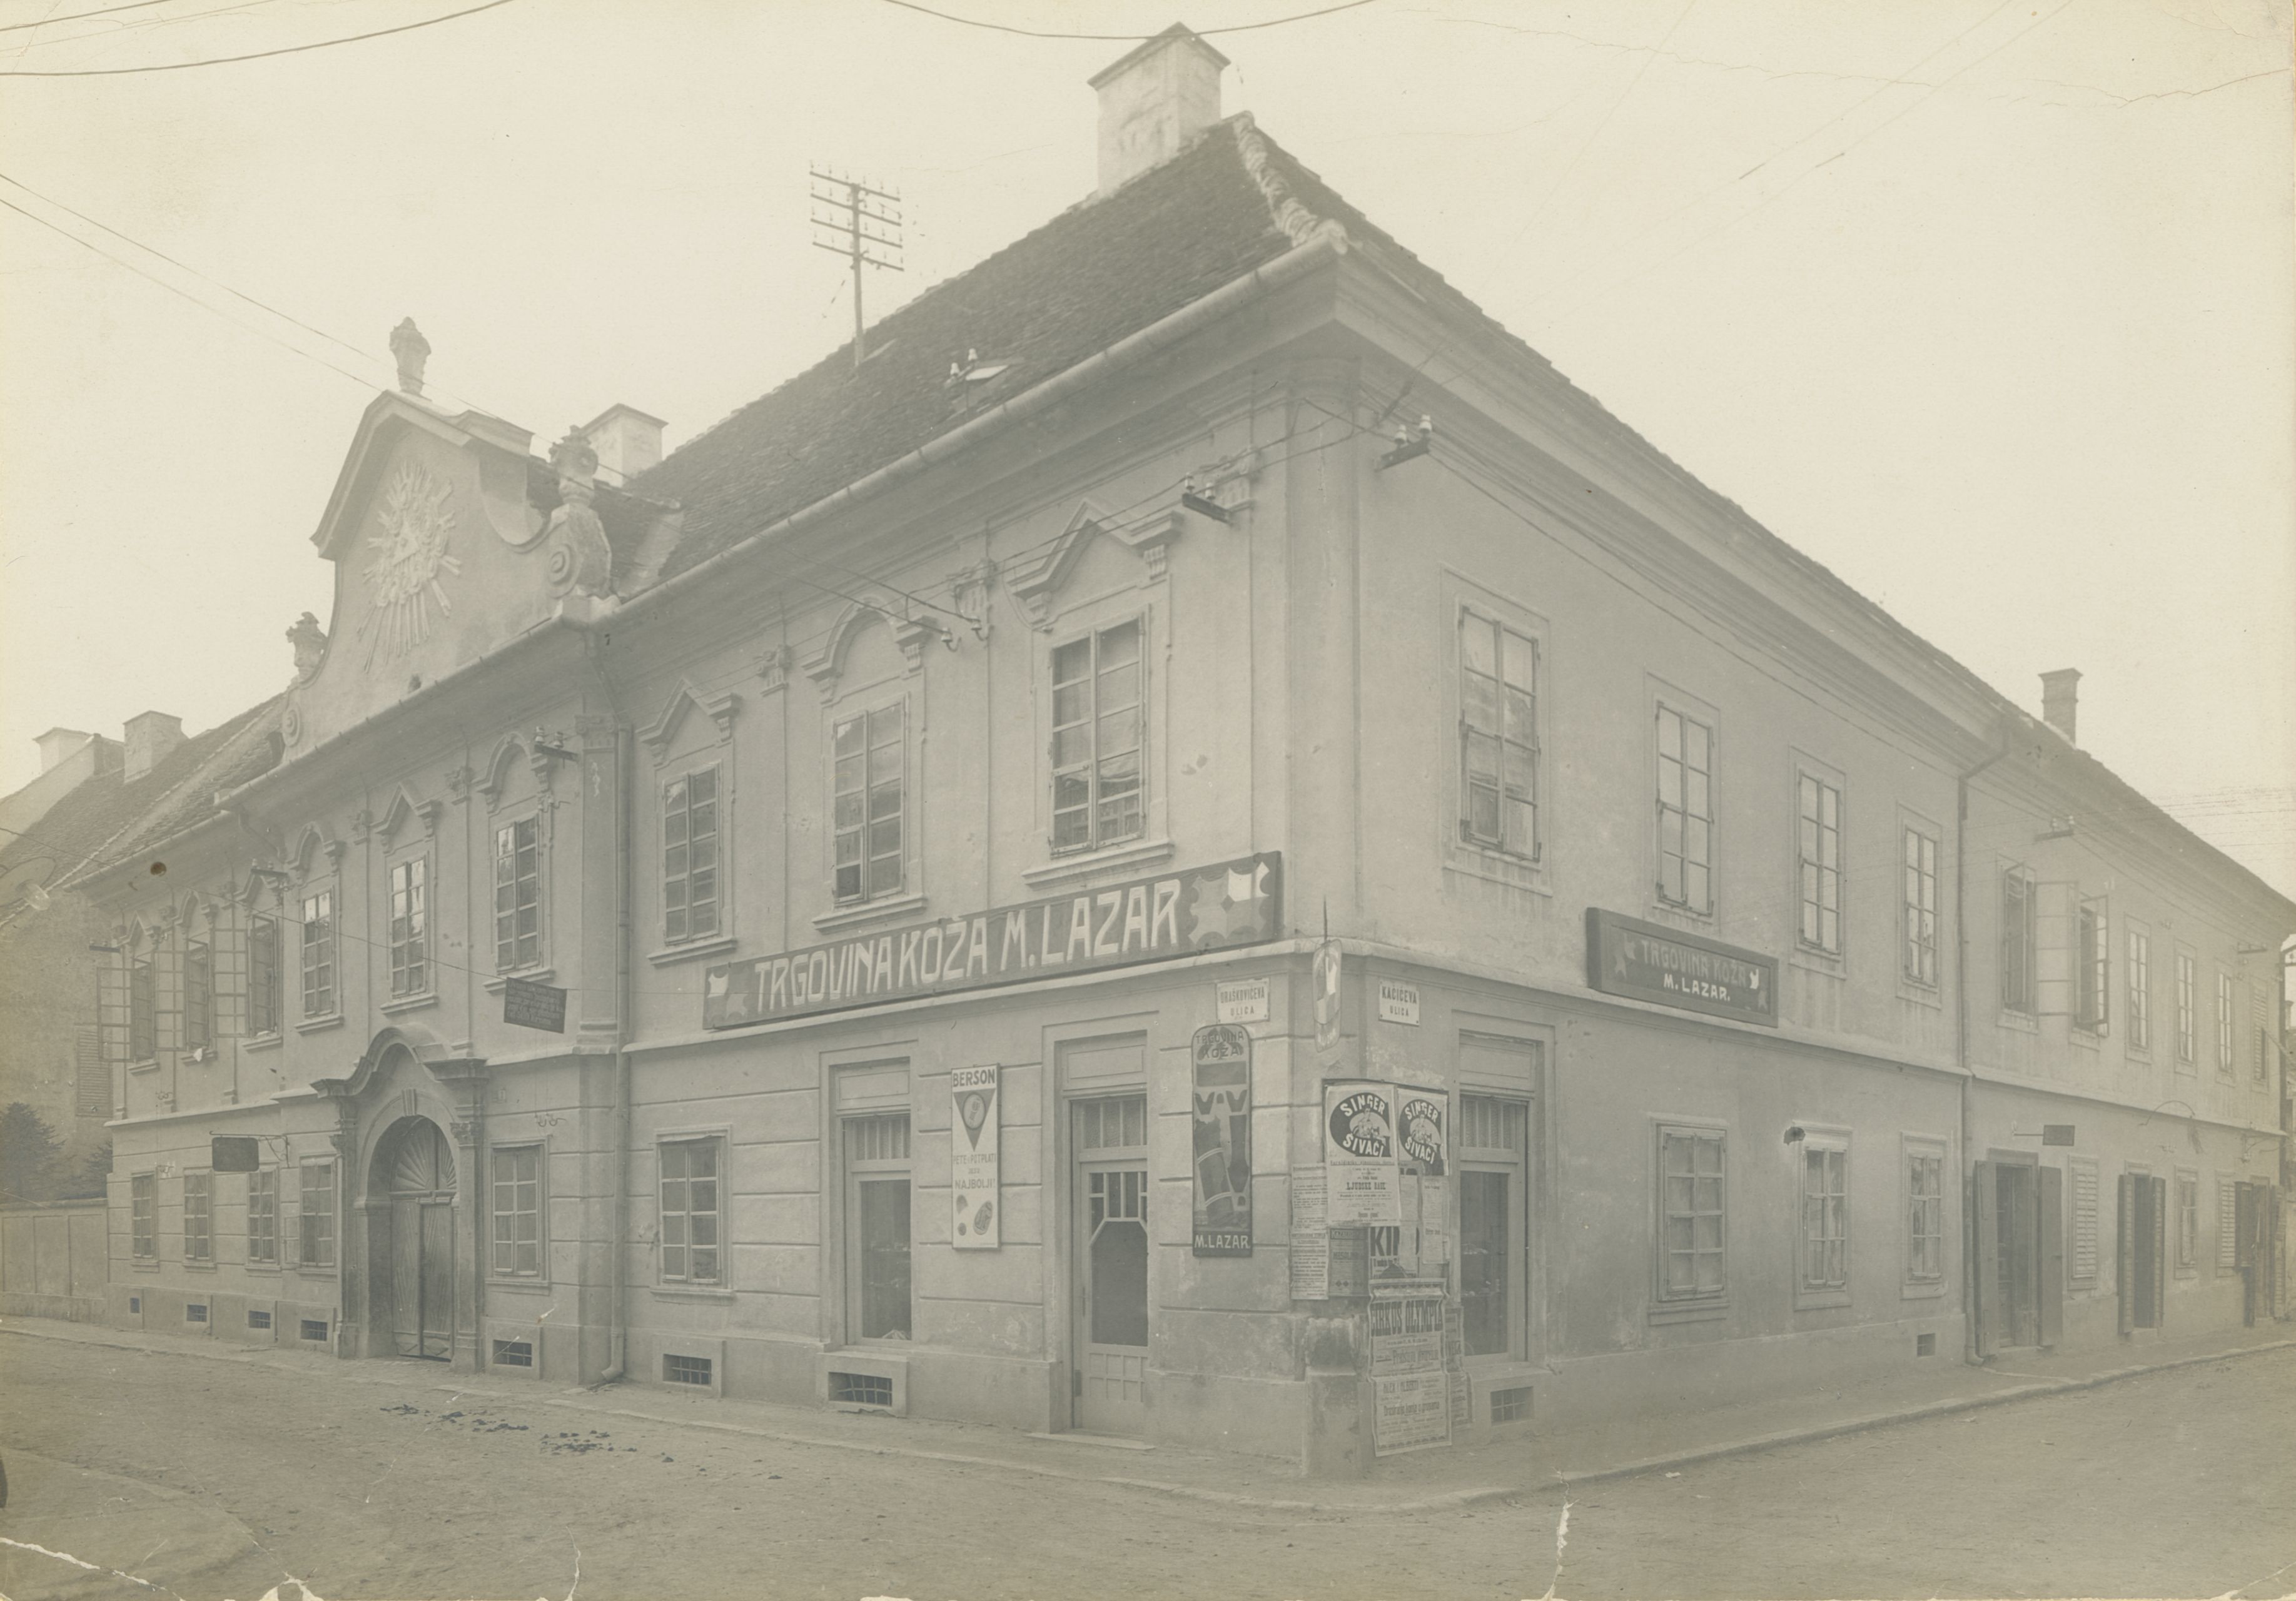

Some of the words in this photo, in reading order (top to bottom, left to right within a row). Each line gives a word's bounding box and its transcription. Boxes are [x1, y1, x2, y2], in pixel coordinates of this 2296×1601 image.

[754, 936, 892, 1014] TRGOVINA
[1041, 879, 1181, 966] LAZAR
[1641, 940, 1709, 979] TRGOVINA
[1663, 972, 1679, 991] M.
[1230, 1006, 1255, 1017] ULICA
[1389, 1005, 1409, 1017] ULICA
[1196, 1031, 1245, 1044] TRGOVINA
[953, 1069, 996, 1088] BERSON
[1340, 1094, 1385, 1117] SINGER
[1404, 1101, 1439, 1123] SINGER
